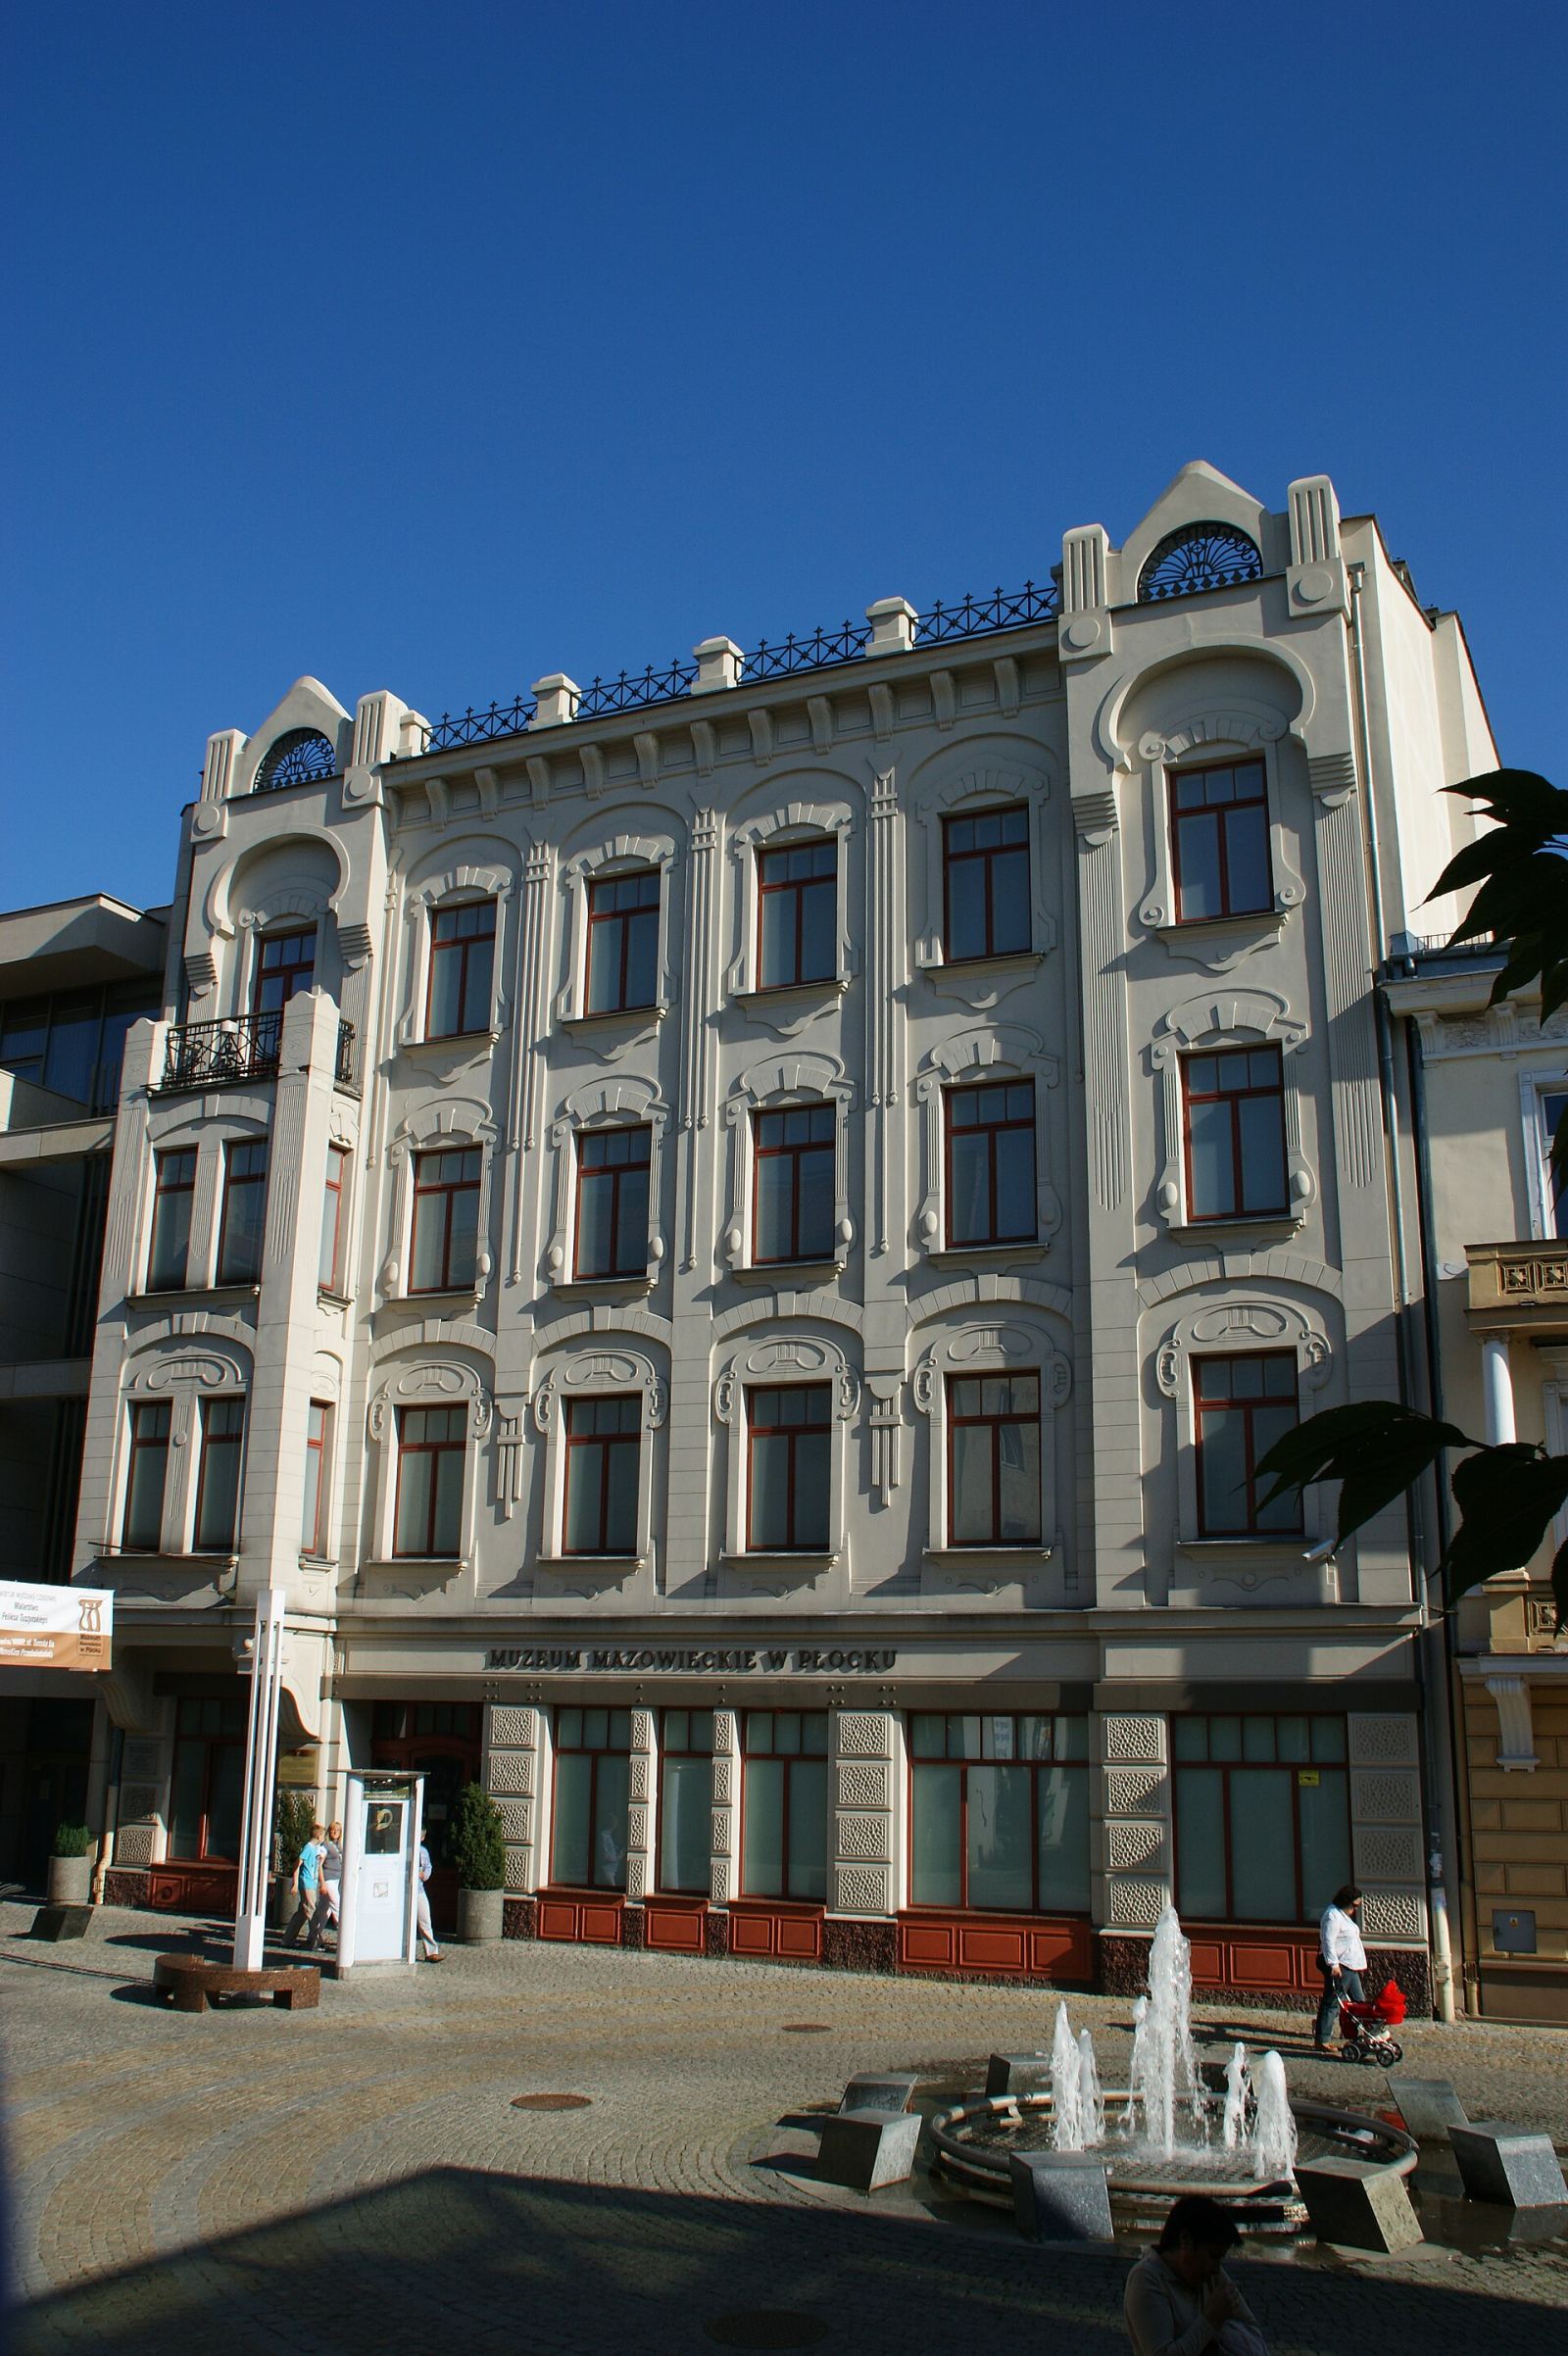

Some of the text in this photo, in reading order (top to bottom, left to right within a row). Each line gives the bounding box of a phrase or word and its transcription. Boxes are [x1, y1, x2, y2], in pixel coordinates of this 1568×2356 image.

[490, 1649, 899, 1670] MUZEUM MAZOWIECKIE W PŁOCKU
